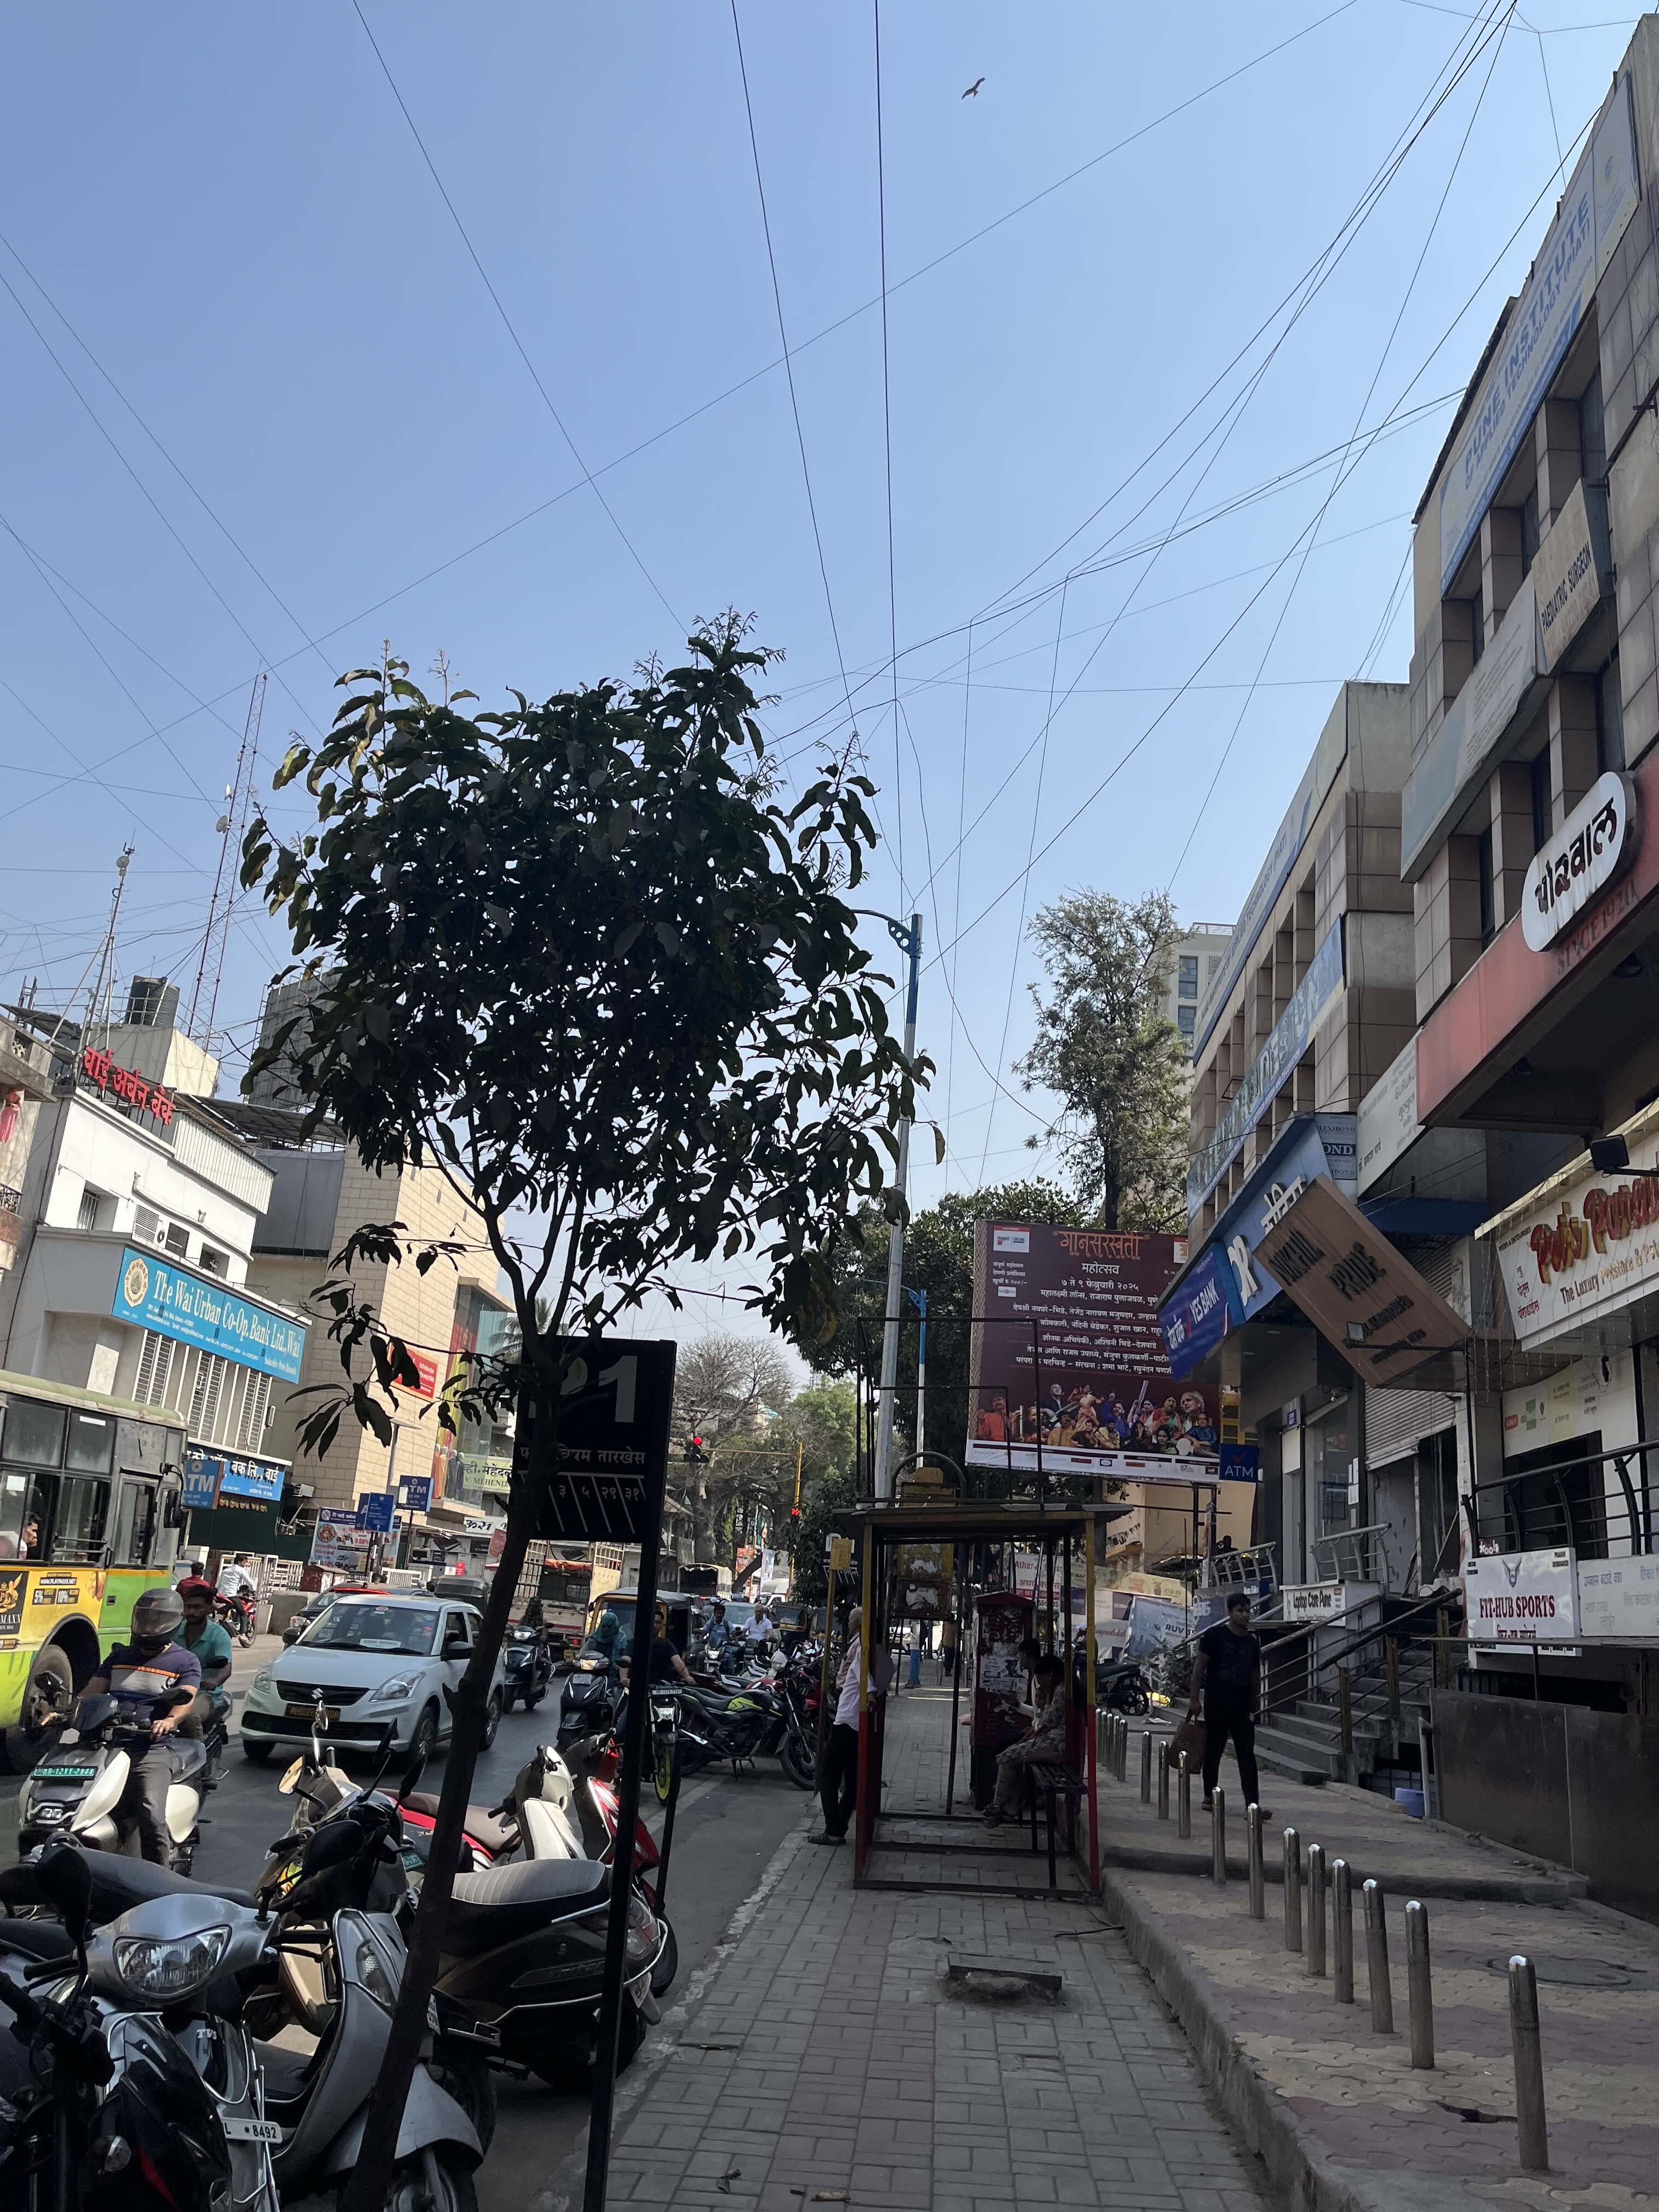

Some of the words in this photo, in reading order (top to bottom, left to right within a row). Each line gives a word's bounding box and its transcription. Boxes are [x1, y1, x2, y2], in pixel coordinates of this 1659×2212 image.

[1465, 385, 1501, 477] PUNE
[1504, 189, 1590, 391] INSTITUTE
[1465, 463, 1474, 493] OF
[1476, 396, 1505, 470] APPLIED
[1506, 276, 1562, 405] TECHNOLOGY
[1562, 215, 1592, 286] (PIAT)
[1541, 579, 1568, 633] PAEDIATRIC
[1568, 543, 1592, 591] SURGEON
[84, 1045, 115, 1089] वाई
[112, 1066, 150, 1110] अर्बन
[151, 1084, 176, 1126] बँक
[1081, 1261, 1120, 1276] महोत्सव
[1070, 1277, 1075, 1286] ते
[1079, 1280, 1084, 1288] ९
[1086, 1277, 1114, 1291] फेब्रुवारी
[1118, 1282, 1139, 1291] २०२५
[1561, 1286, 1575, 1304] The
[1575, 1274, 1600, 1297] Luxury
[1599, 1257, 1633, 1284] Petstore
[1041, 1289, 1068, 1299] महालक्ष्मी
[1069, 1290, 1087, 1300] लॉन्स,
[1090, 1293, 1113, 1302] राजाराम
[1148, 1294, 1158, 1306] पुणे
[1189, 1300, 1203, 1324] YES
[1200, 1278, 1220, 1315] BANK
[154, 1269, 173, 1305] The
[174, 1279, 195, 1313] Wai
[194, 1288, 222, 1325] Urban
[222, 1302, 249, 1342] Co-Op.
[249, 1314, 271, 1346] Bank
[286, 1330, 301, 1358] Wai
[1138, 1312, 1157, 1321] उल्हास
[1045, 1345, 1060, 1355] आणि
[1062, 1348, 1079, 1356] राजस
[1043, 1357, 1066, 1367] पदचिन्ह
[597, 1446, 646, 1466] तारखेस
[266, 1465, 279, 1484] वाई
[1224, 1465, 1254, 1479] ATM
[559, 1485, 566, 1498] ३
[582, 1486, 590, 1499] ५
[1613, 1572, 1622, 1584] वडा
[34, 1590, 44, 1604] 5%
[58, 1590, 69, 1603] 10%
[1293, 1592, 1307, 1612] Laptop
[1308, 1592, 1319, 1608] Care
[1319, 1589, 1331, 1608] Pune
[1480, 1597, 1514, 1618] FIT-HUB
[1516, 1595, 1556, 1618] SPORTS
[196, 2028, 217, 2040] TVS
[252, 2124, 277, 2138] 8492
